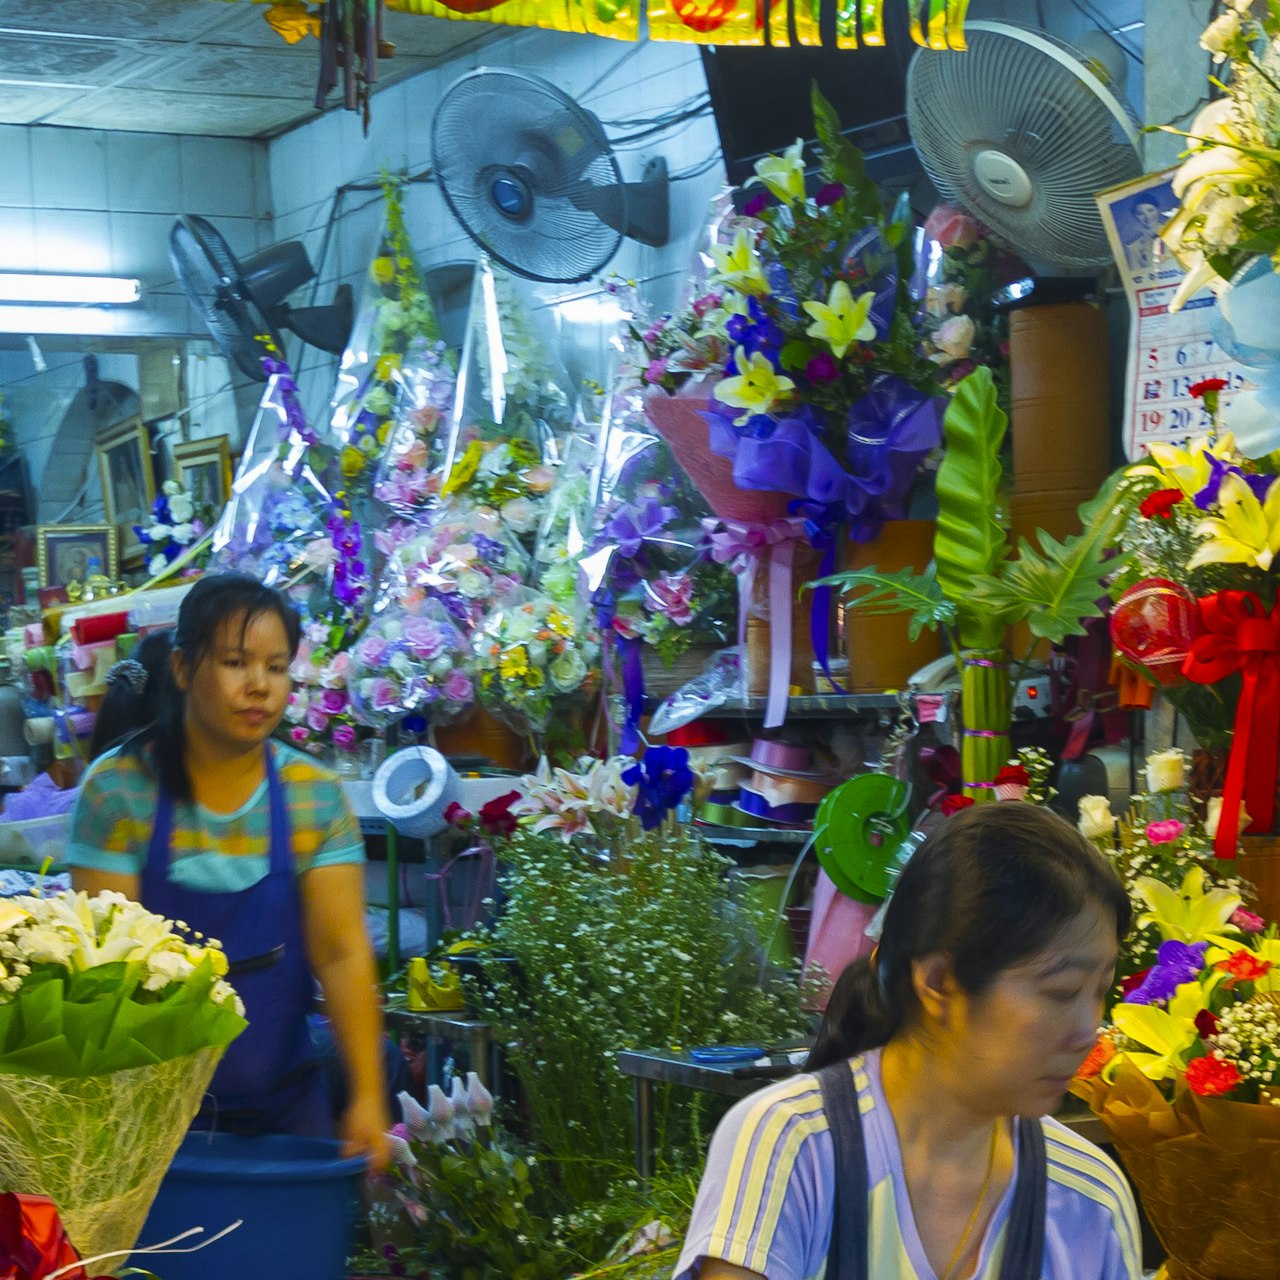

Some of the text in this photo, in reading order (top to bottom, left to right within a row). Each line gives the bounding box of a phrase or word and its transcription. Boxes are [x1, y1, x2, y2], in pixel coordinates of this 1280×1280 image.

[1176, 345, 1187, 366] 6
[1141, 410, 1164, 432] 19
[1170, 408, 1192, 429] 20
